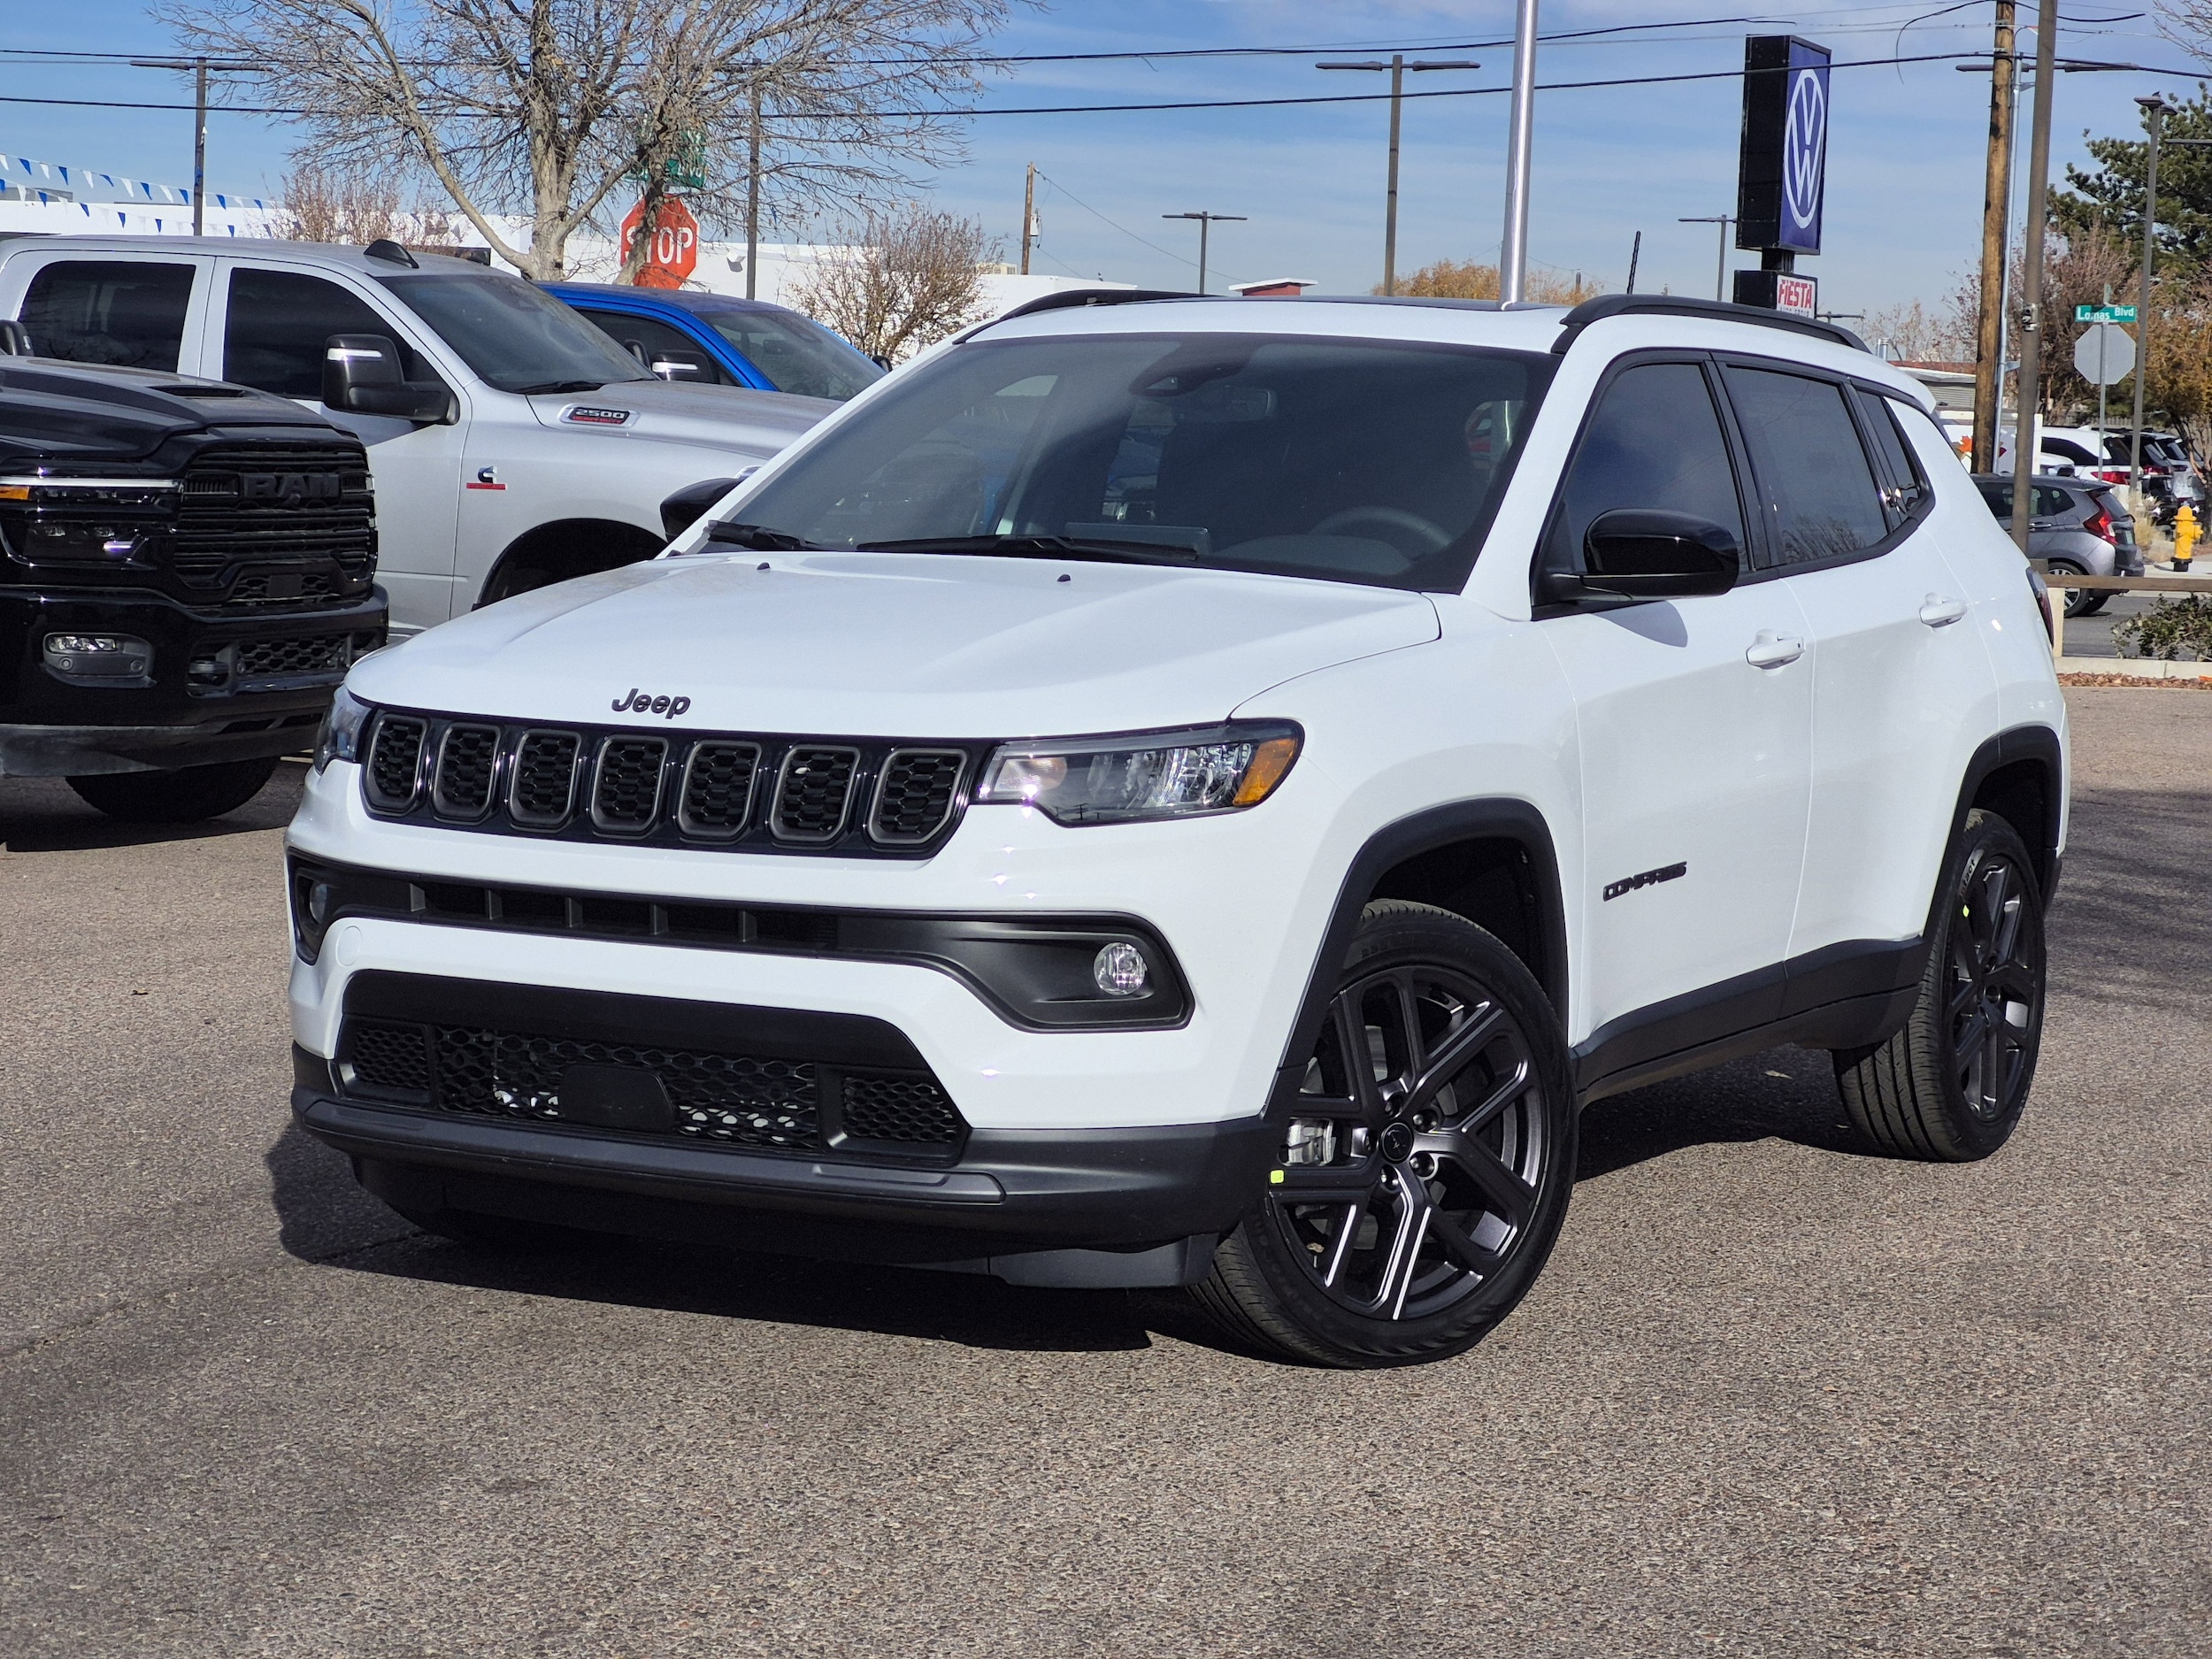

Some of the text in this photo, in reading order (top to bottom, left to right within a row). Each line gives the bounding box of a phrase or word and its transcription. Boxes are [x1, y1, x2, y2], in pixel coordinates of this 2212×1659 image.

[1778, 279, 1813, 309] FIESTA
[2077, 306, 2135, 320] Lomas Blvd
[575, 408, 625, 419] 2500
[243, 473, 341, 498] RAM
[611, 687, 691, 720] Jeep
[1602, 860, 1687, 902] COMPASS
